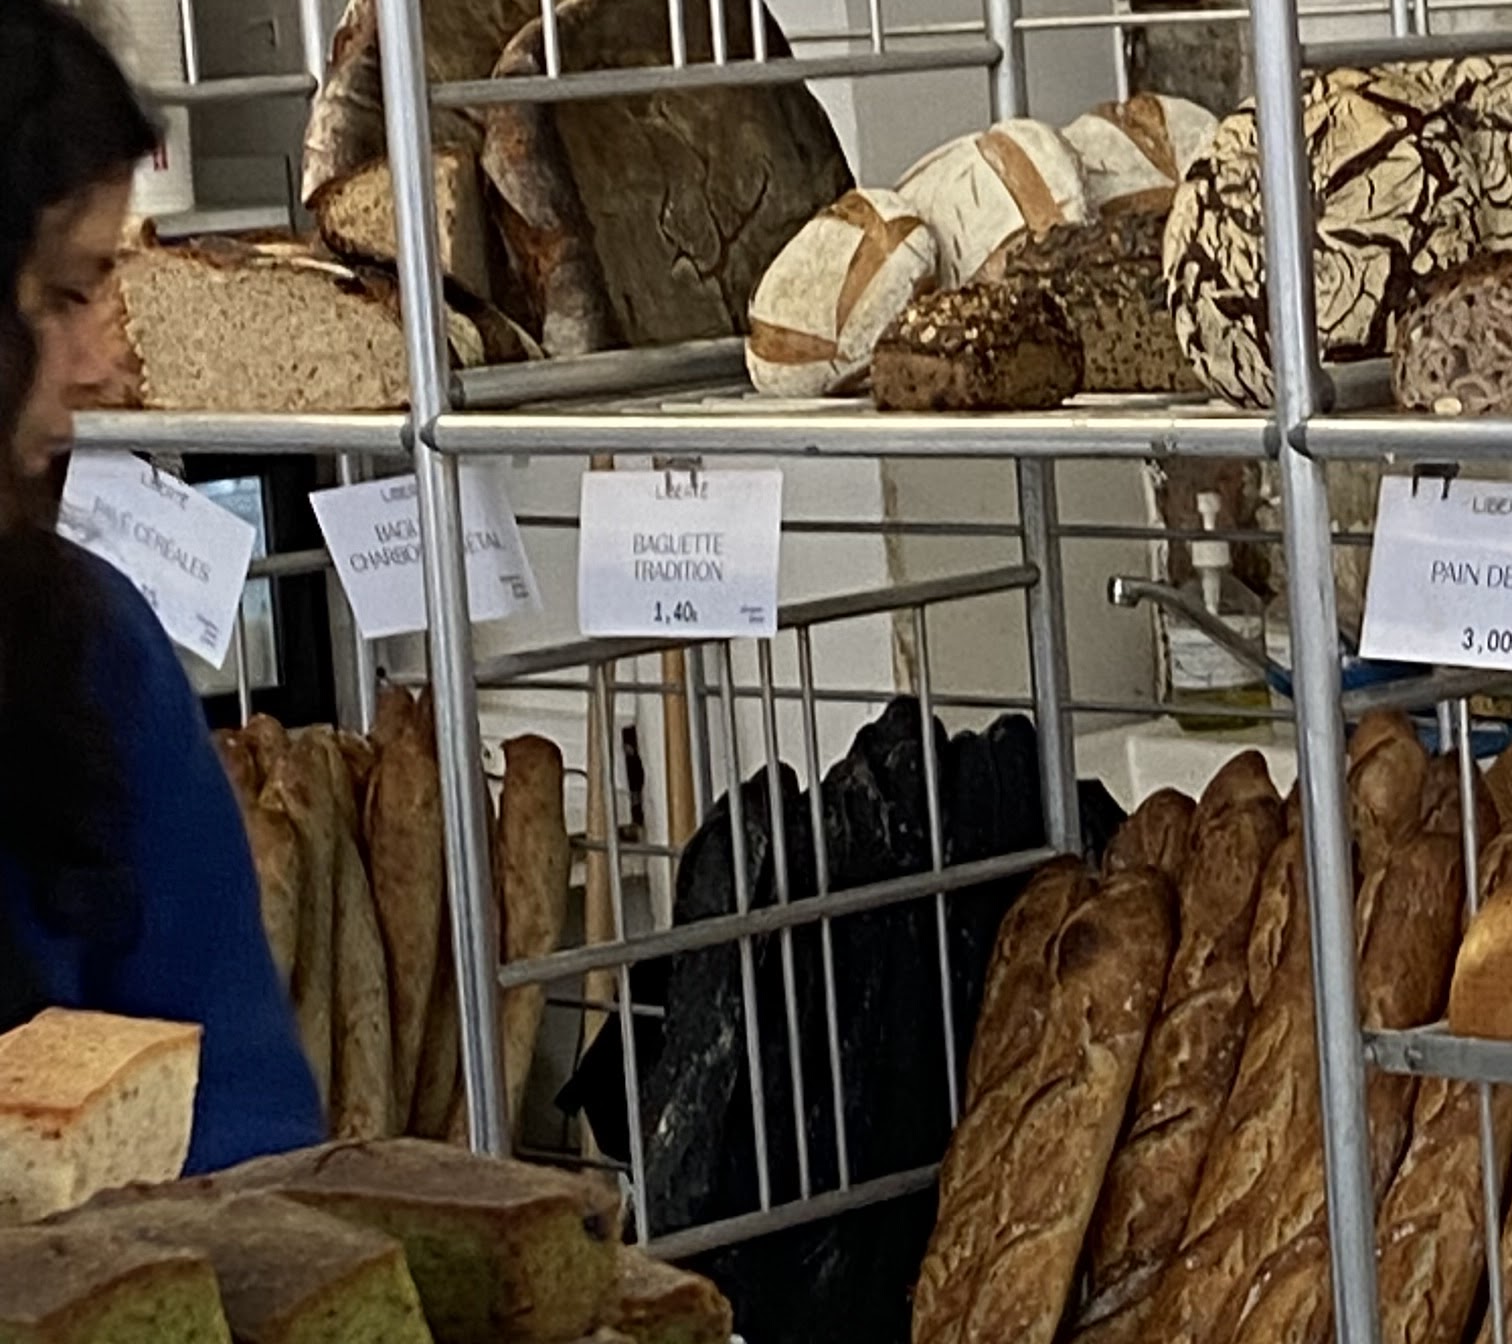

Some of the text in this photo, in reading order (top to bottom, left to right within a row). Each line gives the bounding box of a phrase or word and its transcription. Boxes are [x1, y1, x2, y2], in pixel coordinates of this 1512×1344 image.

[632, 531, 726, 556] BAGUETTE
[633, 559, 725, 583] TRADITION
[1430, 559, 1481, 587] PAIN
